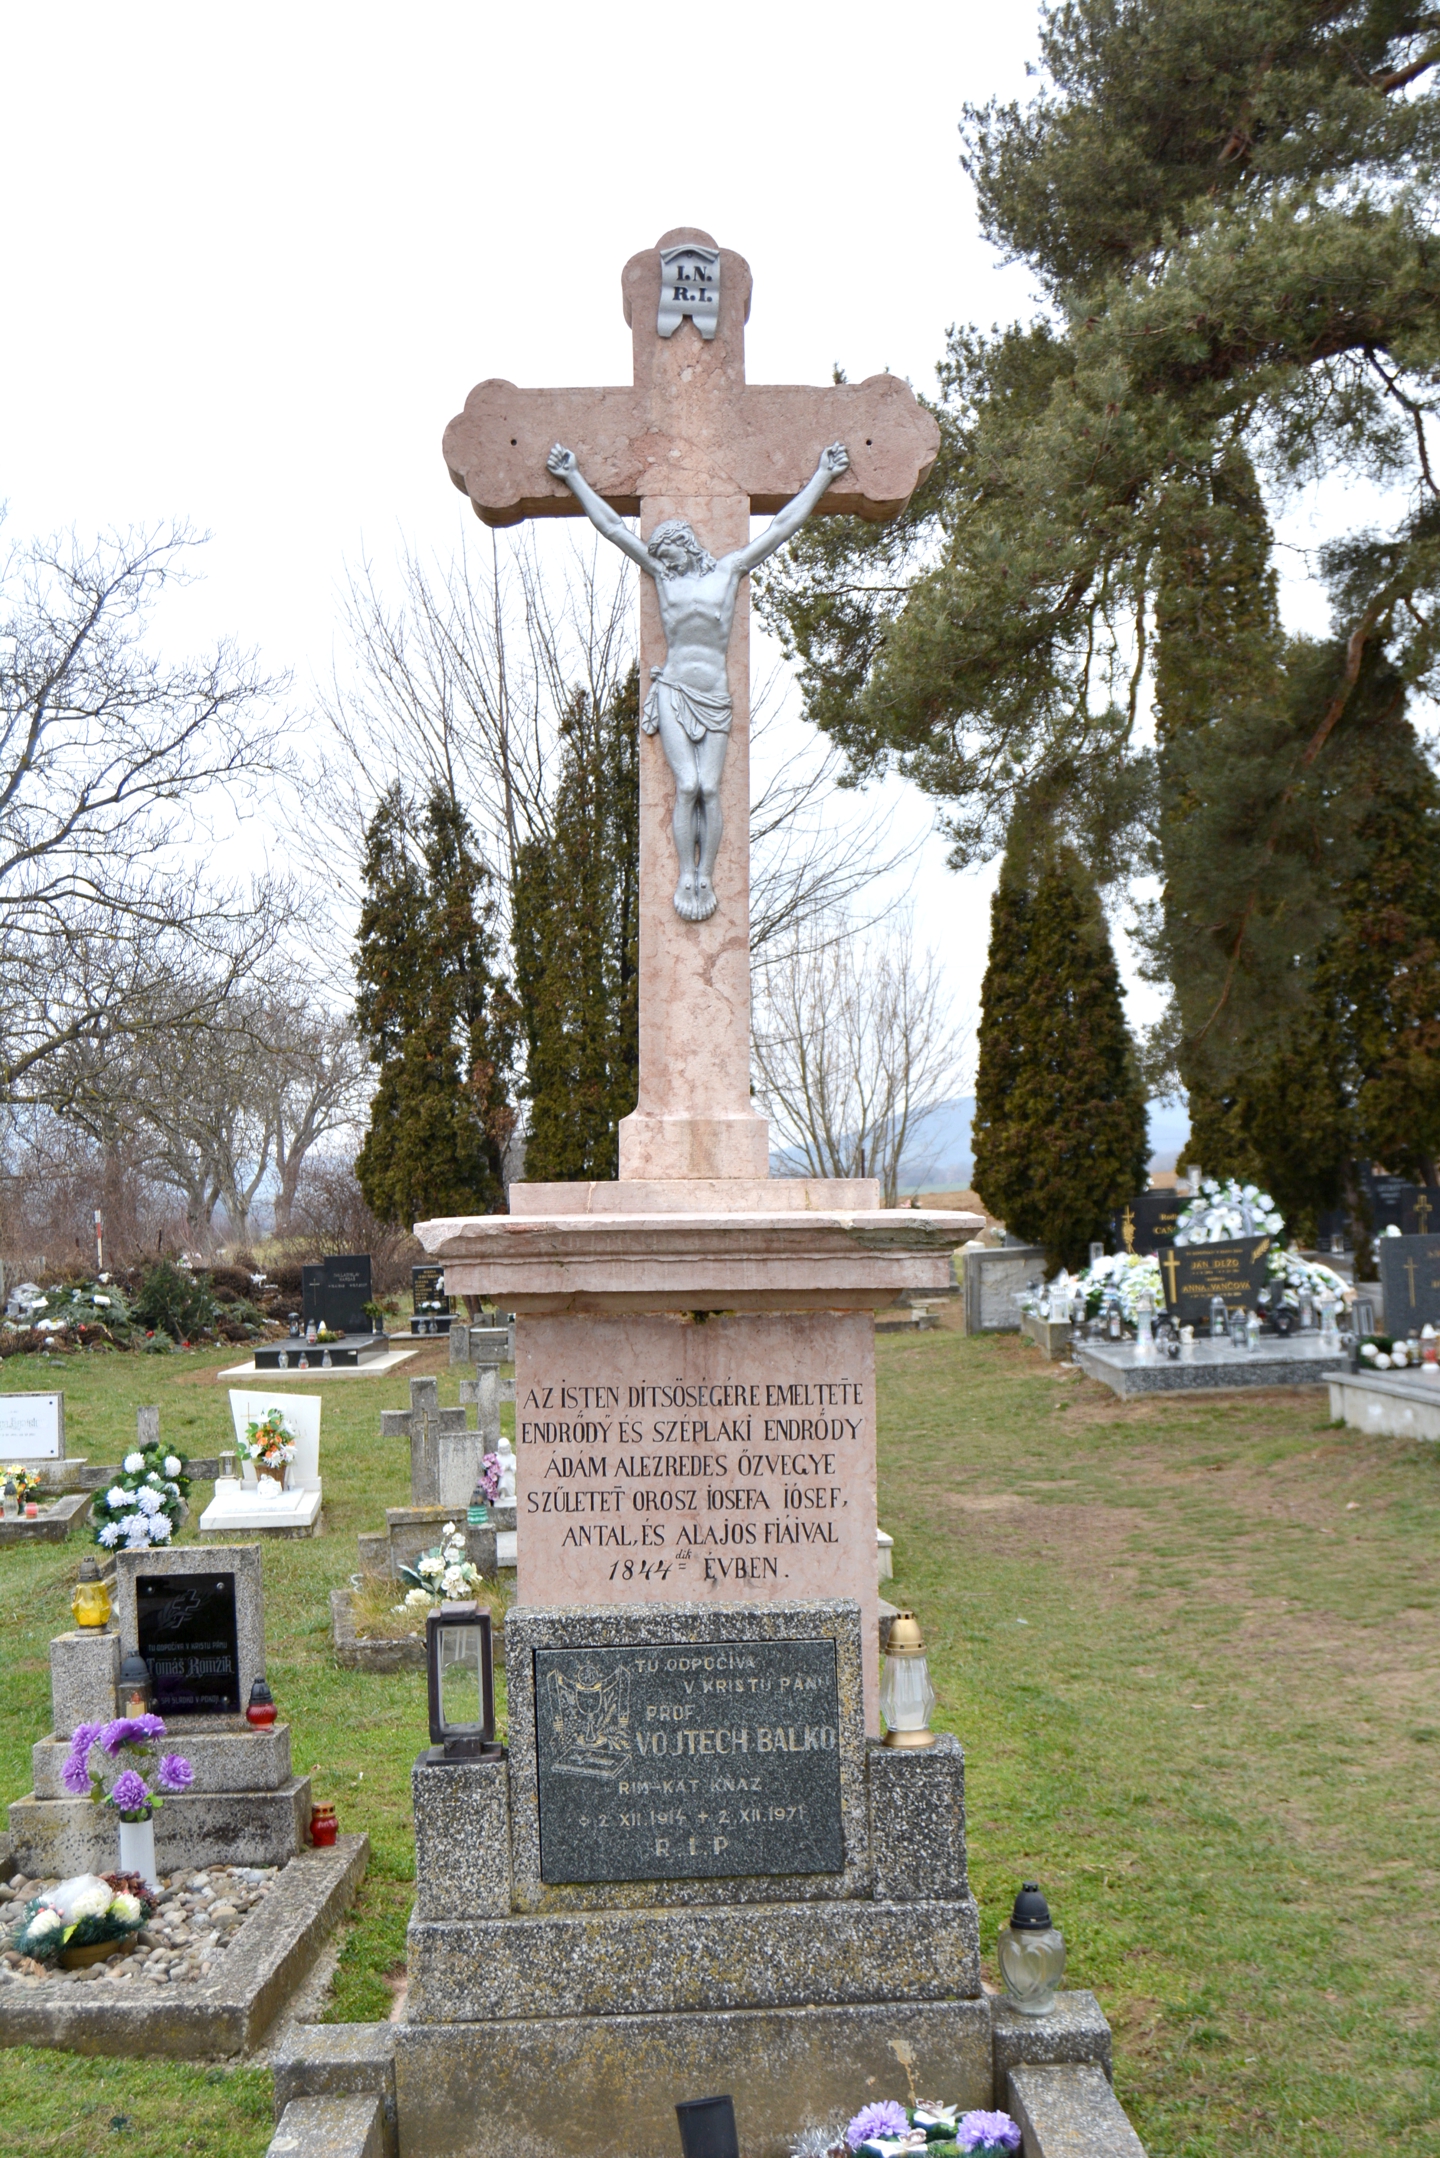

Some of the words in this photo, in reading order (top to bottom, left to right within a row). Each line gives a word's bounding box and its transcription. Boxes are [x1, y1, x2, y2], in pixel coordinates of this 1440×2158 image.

[523, 1387, 554, 1409] AZ
[619, 1414, 643, 1443] ÉS
[544, 1449, 607, 1479] ÁDÁM
[614, 1455, 728, 1478] ALEZREDES
[633, 1489, 697, 1511] OROSZ
[641, 1518, 665, 1546] ÉS
[635, 1658, 659, 1673] TU
[683, 1680, 695, 1694] V
[702, 1677, 771, 1694] KRISTU
[636, 1728, 748, 1757] VOJTECH
[756, 1725, 837, 1753] BALKO
